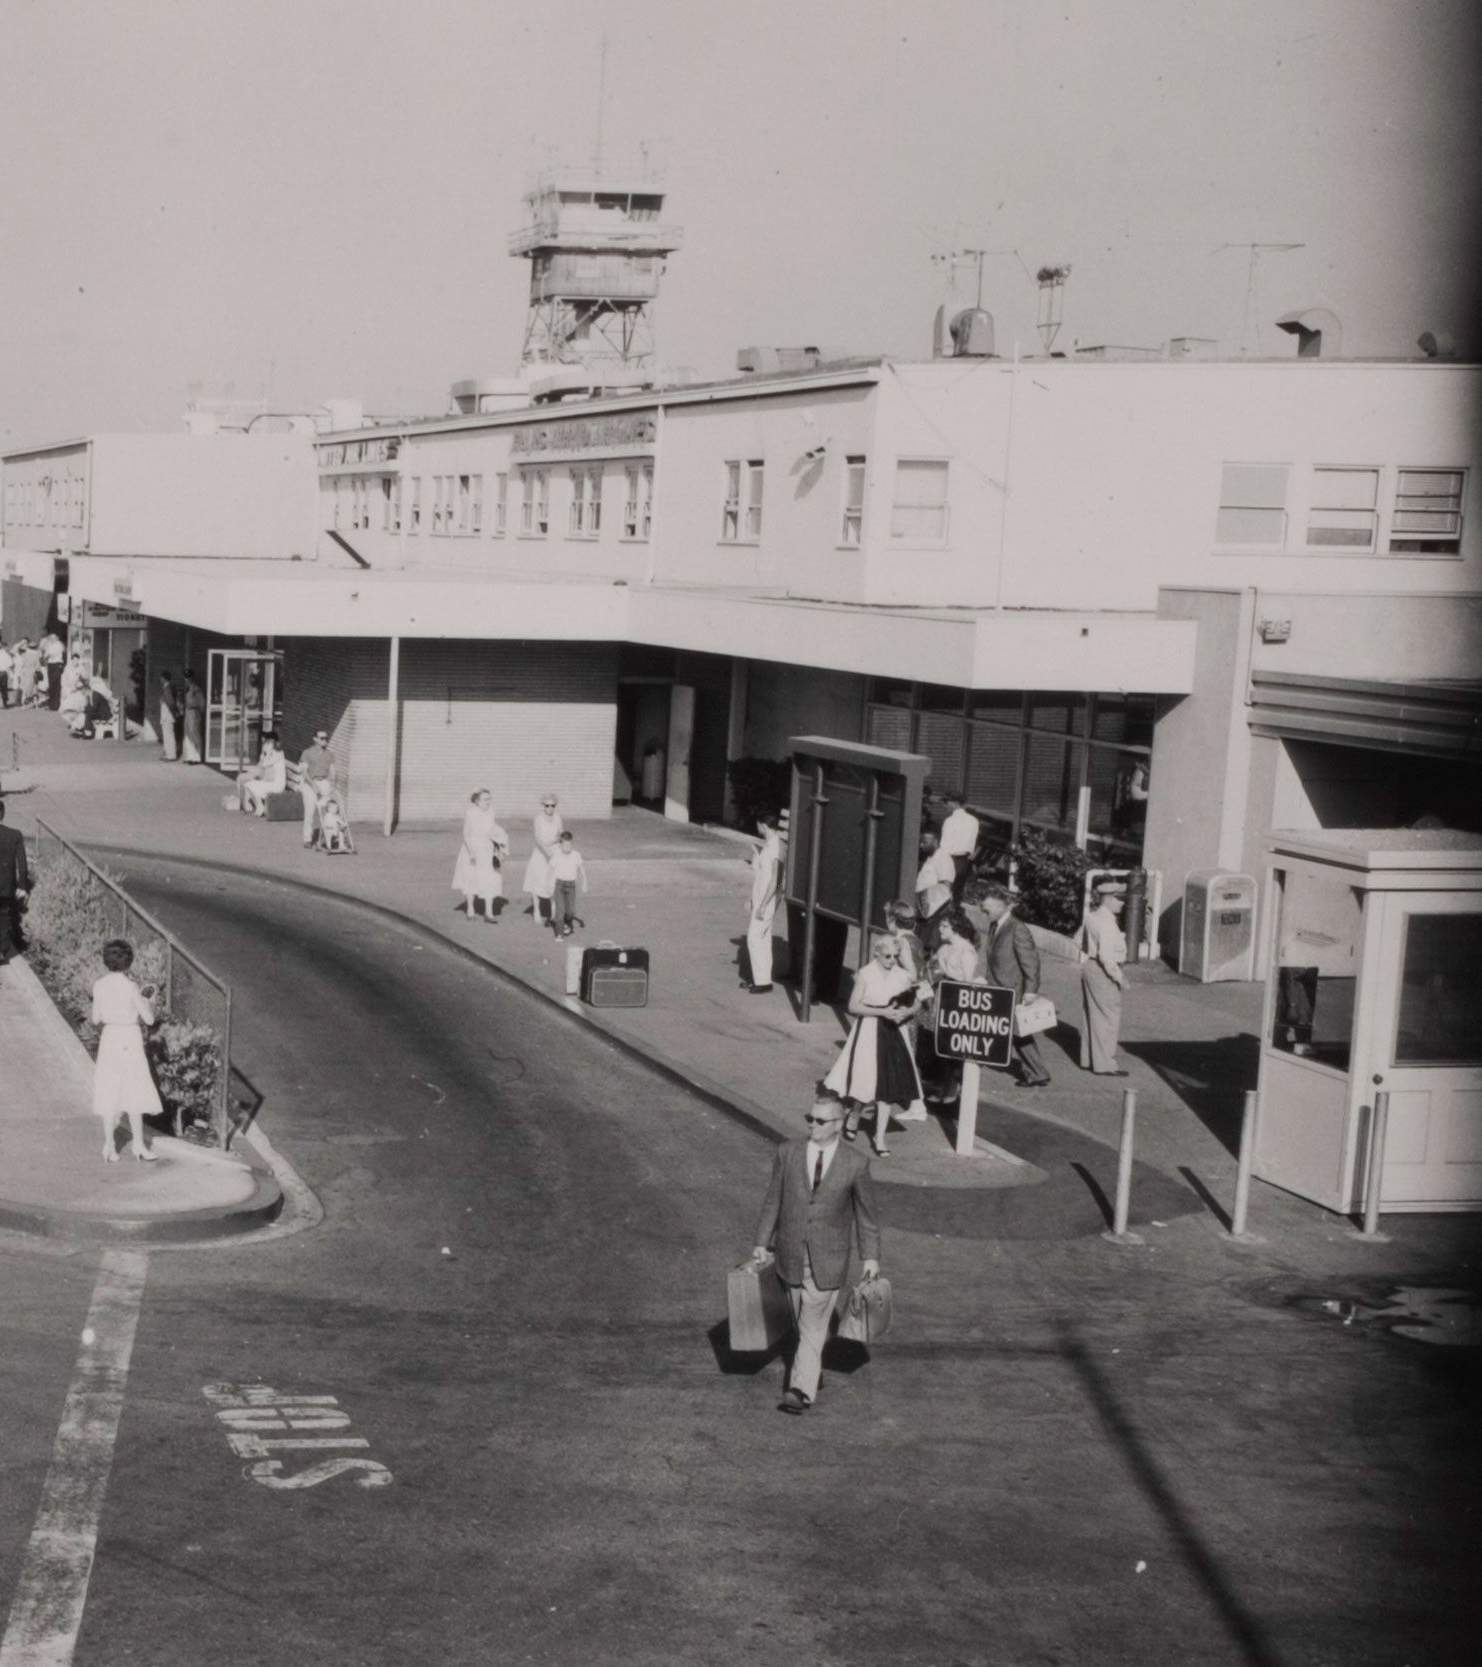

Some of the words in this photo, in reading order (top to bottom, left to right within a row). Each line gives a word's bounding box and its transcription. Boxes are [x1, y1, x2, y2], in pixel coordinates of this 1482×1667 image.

[958, 989, 992, 1011] BUS
[939, 1009, 1010, 1036] LOADING
[950, 1033, 994, 1056] ONLY
[202, 1382, 394, 1490] STOP
